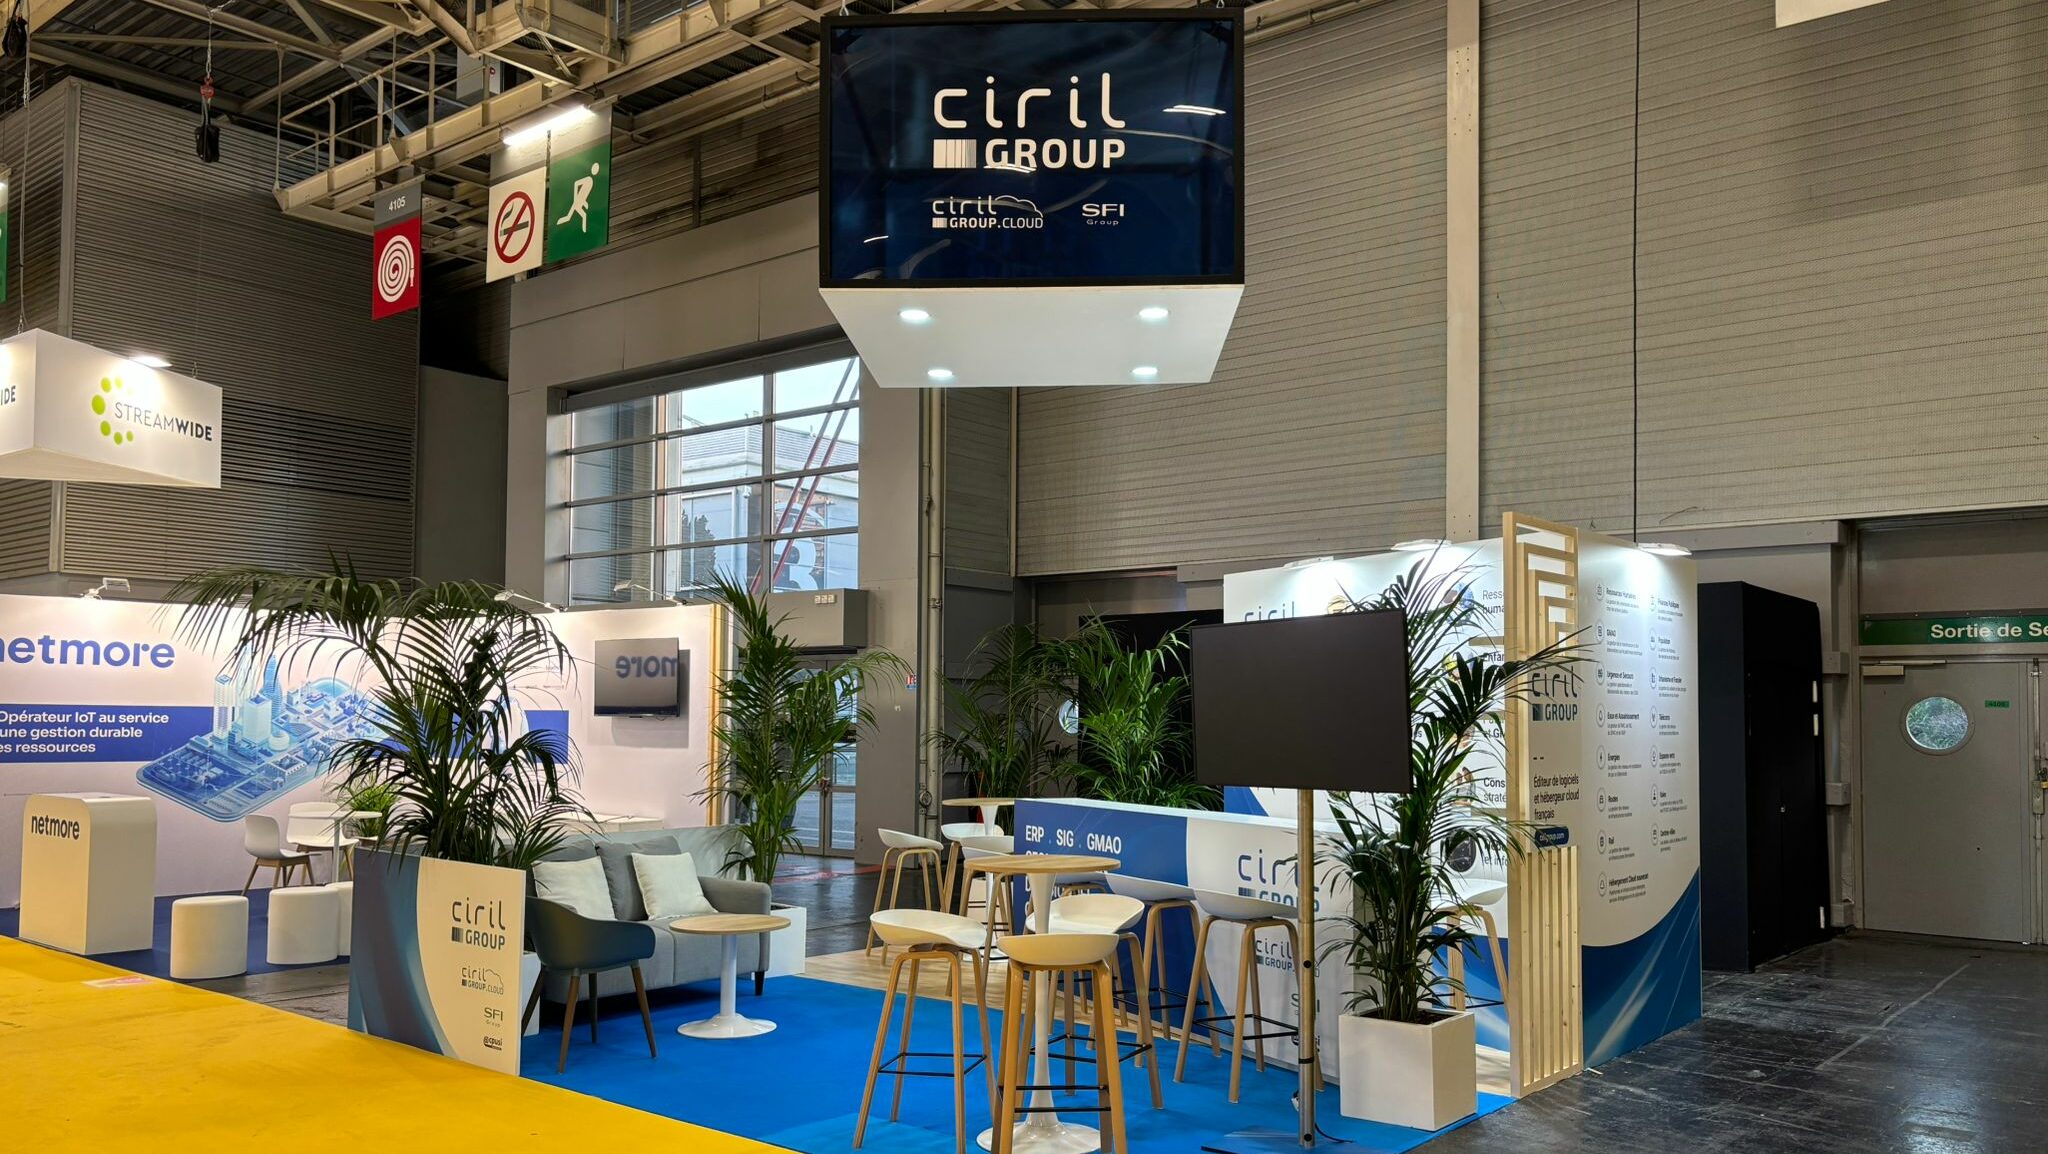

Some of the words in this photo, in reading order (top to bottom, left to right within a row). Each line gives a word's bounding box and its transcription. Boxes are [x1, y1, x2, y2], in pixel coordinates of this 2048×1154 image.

[933, 72, 1126, 129] ciril
[985, 138, 1126, 169] GROUP
[932, 195, 997, 215] ciril
[1082, 203, 1125, 217] SFI
[950, 217, 1044, 229] GROUP.CLOUD
[114, 402, 213, 442] STREAMWIDE
[1930, 623, 1991, 639] Sortie
[1997, 622, 2022, 637] de
[0, 634, 176, 669] etmore
[75, 712, 96, 723] IoT
[99, 714, 116, 724] au
[119, 713, 170, 724] service
[1545, 703, 1578, 722] GROUP
[30, 727, 84, 741] gestion
[89, 727, 144, 738] durable
[16, 743, 97, 753] ressources
[1566, 789, 1580, 801] cloud
[1534, 806, 1555, 822] français
[31, 814, 80, 840] netmore
[1025, 824, 1045, 843] ERP
[1056, 828, 1074, 848] SIG
[1087, 833, 1122, 854] GMAO
[452, 896, 506, 931] ciril
[465, 929, 506, 951] GROUP
[461, 965, 486, 982] ciril
[484, 1007, 504, 1022] SFI
